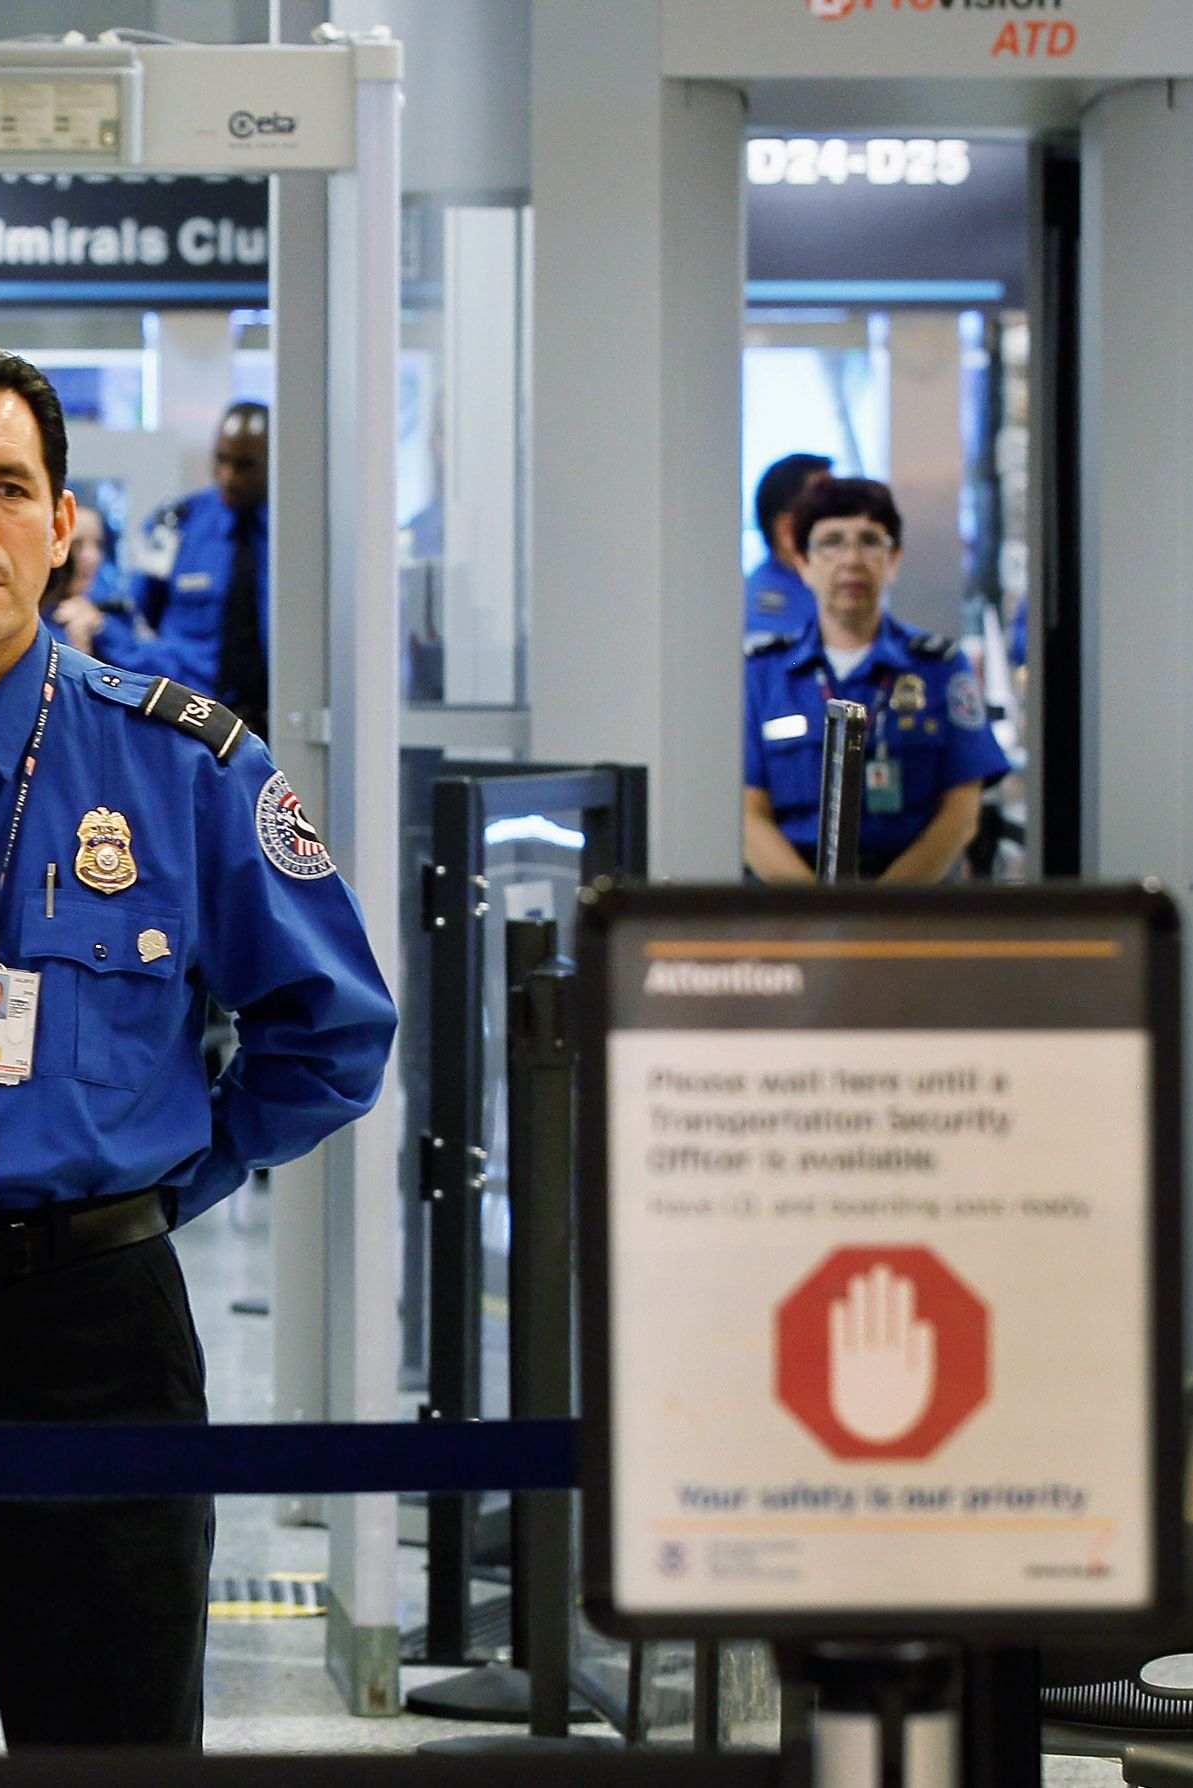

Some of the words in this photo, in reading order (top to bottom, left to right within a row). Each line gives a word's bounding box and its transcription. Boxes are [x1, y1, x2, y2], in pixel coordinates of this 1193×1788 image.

[991, 20, 1077, 58] ATD
[746, 138, 969, 185] D24-D25
[177, 216, 269, 266] Clu
[177, 694, 217, 728] TSA
[644, 960, 803, 995] Attention
